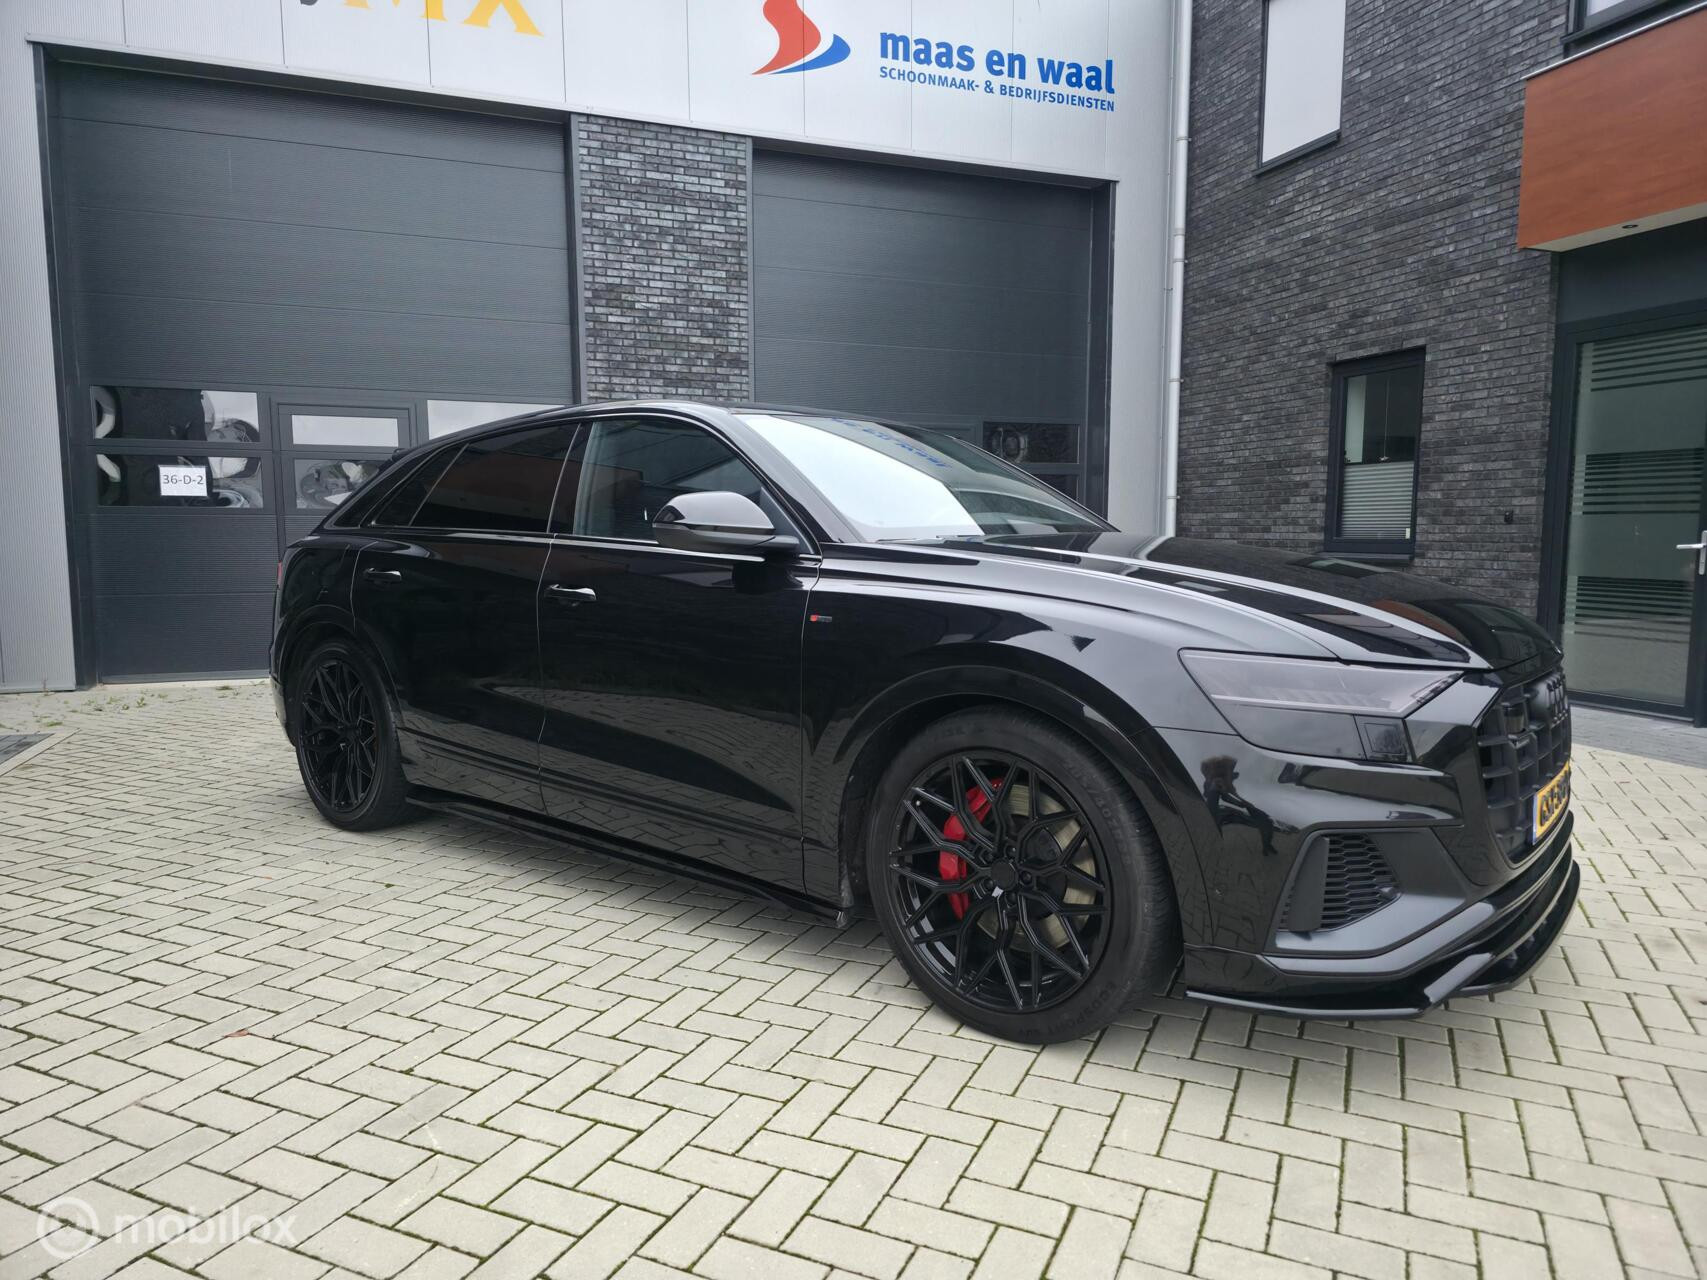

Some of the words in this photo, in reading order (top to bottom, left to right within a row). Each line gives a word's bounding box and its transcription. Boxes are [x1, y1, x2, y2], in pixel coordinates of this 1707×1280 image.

[879, 32, 976, 72] maas
[985, 50, 1027, 81] en
[1037, 59, 1116, 95] waal
[879, 66, 980, 93] SCHOONMAAK-
[983, 80, 995, 95] &
[999, 84, 1115, 112] BEDRIJFSDIENSTEN
[162, 474, 204, 485] 36-D-2
